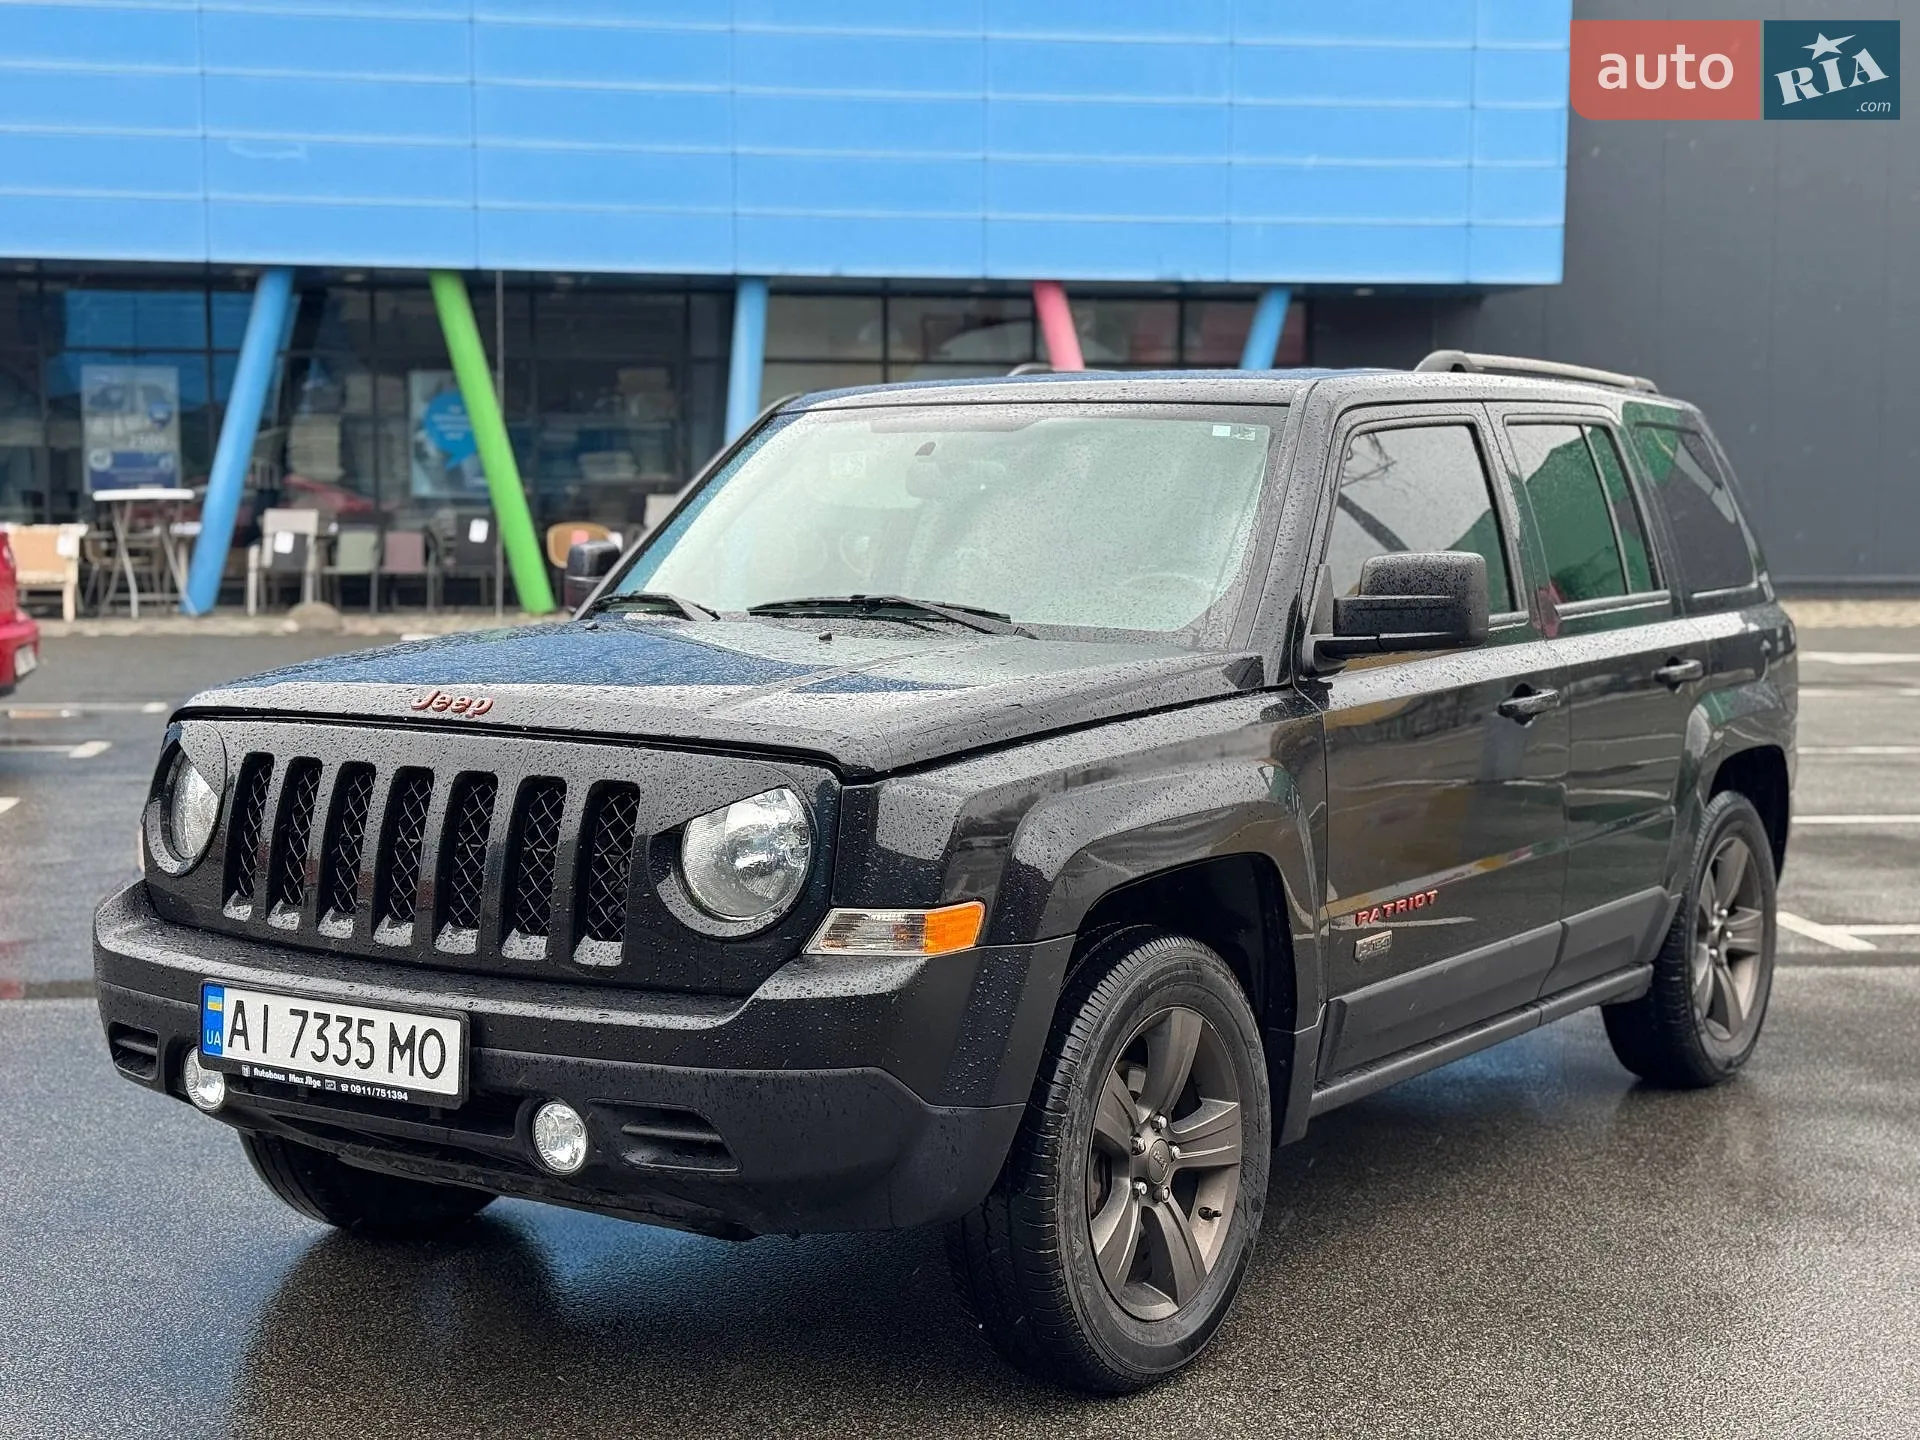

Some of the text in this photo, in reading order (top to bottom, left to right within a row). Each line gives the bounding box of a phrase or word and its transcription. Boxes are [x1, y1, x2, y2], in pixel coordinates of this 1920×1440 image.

[410, 689, 494, 719] Jeep
[1355, 889, 1438, 927] PATRIOT
[206, 1031, 222, 1047] UA
[227, 1000, 446, 1080] AI 7335 MO
[253, 1067, 286, 1081] Autohaus
[350, 1084, 409, 1101] 0911/751394
